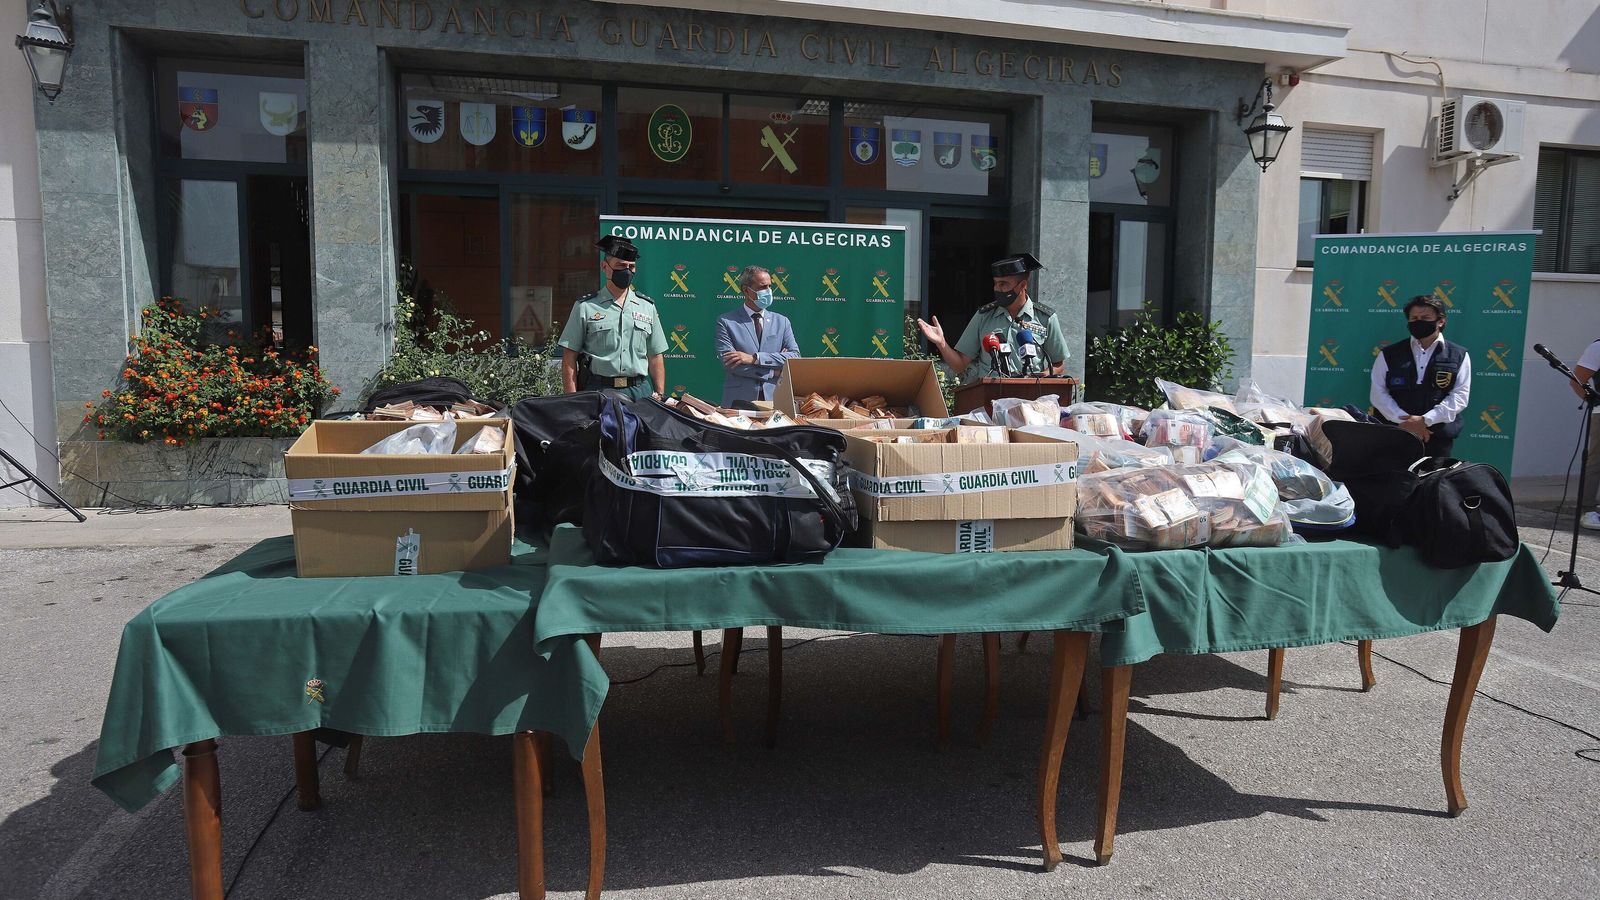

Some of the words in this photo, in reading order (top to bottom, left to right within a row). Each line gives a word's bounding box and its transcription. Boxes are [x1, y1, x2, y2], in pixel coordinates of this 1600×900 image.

[239, 0, 575, 43] COMANDANCIA
[599, 16, 778, 58] GUARDIA
[800, 32, 901, 69] CIVIL
[923, 45, 1123, 88] ALGECIRAS
[611, 225, 753, 243] COMANDANCIA
[759, 230, 782, 244] DE
[787, 231, 892, 248] ALGECIRAS
[1321, 244, 1419, 254] COMANDANCIA
[1422, 244, 1441, 253] DE
[1443, 242, 1527, 253] ALGECIRAS
[631, 454, 687, 470] GUARDIA
[333, 480, 392, 495] GUARDIA
[395, 478, 429, 492] CIVIL
[468, 473, 508, 489] GUARD
[716, 469, 749, 484] CIVIL
[860, 477, 892, 494] GUARDIA
[895, 479, 926, 494] CIVIL
[959, 473, 1008, 490] GUARDIA
[1011, 469, 1039, 485] CIVIL
